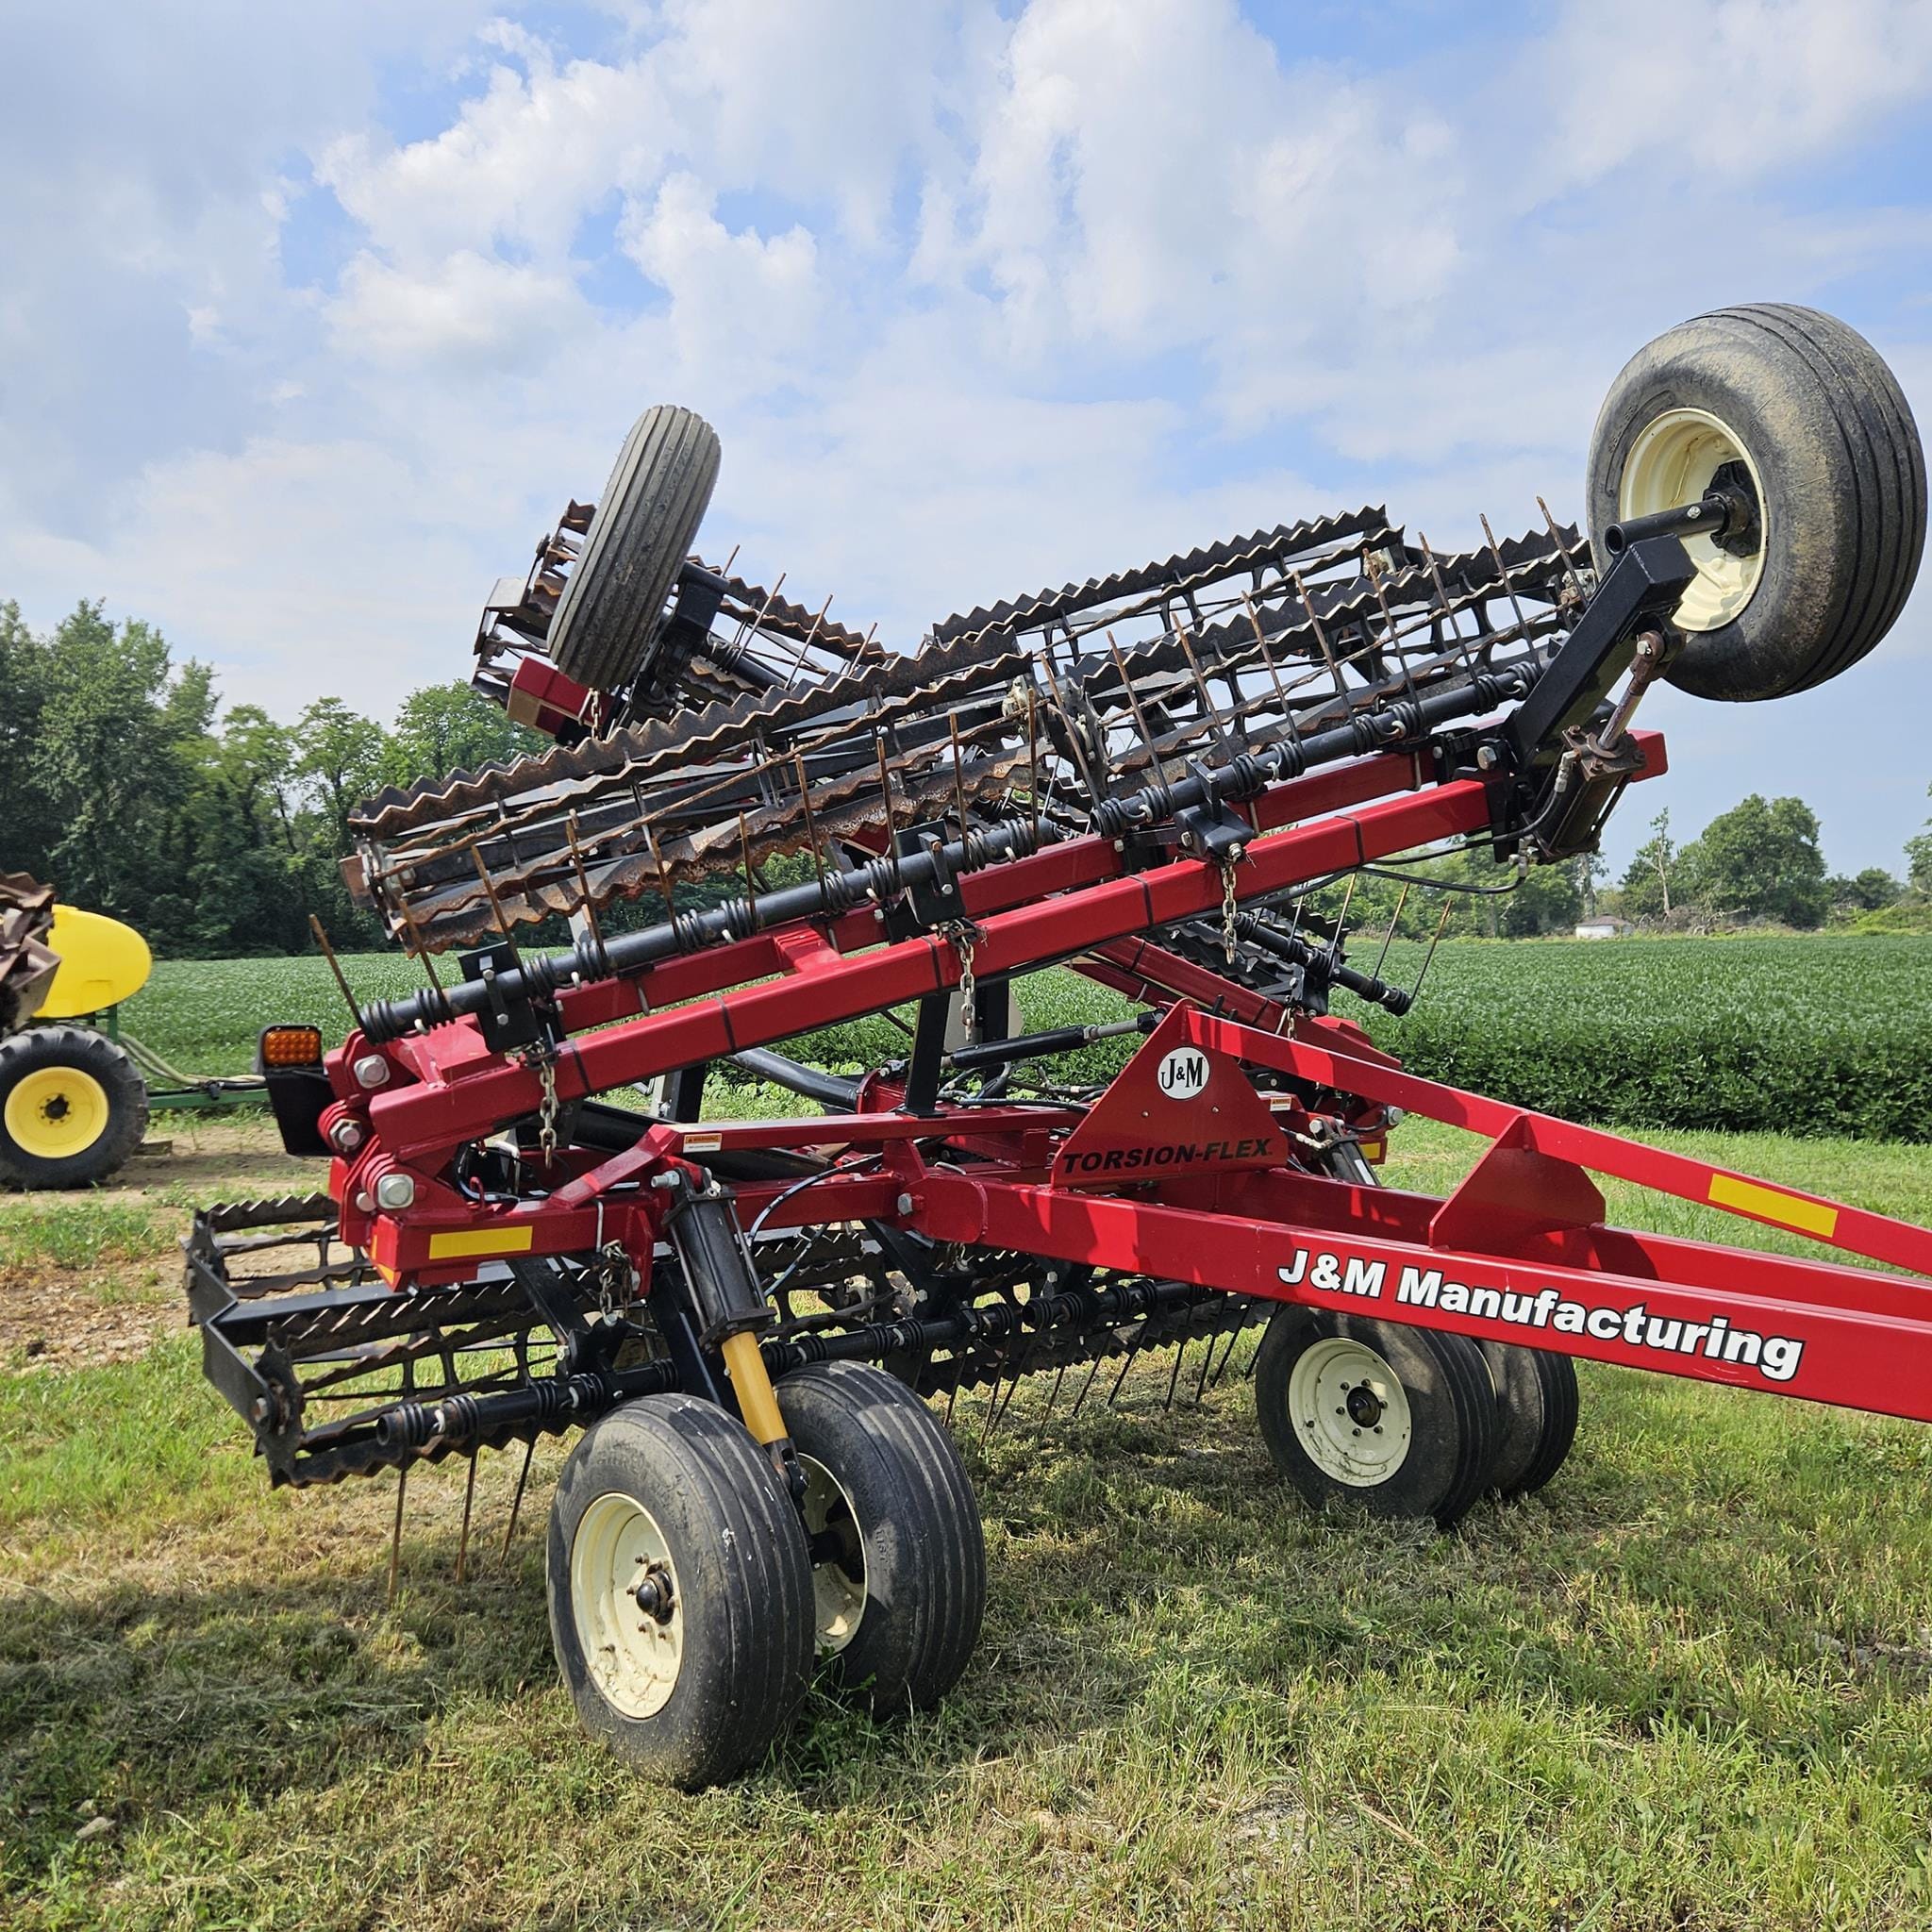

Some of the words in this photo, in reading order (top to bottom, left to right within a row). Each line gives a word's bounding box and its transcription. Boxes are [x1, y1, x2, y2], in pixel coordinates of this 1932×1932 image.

[1161, 1057, 1204, 1090] J&M
[1063, 1138, 1273, 1174] TORSION-FLEX
[1277, 1249, 1387, 1299] J&M
[1395, 1266, 1806, 1381] Manufacturing
